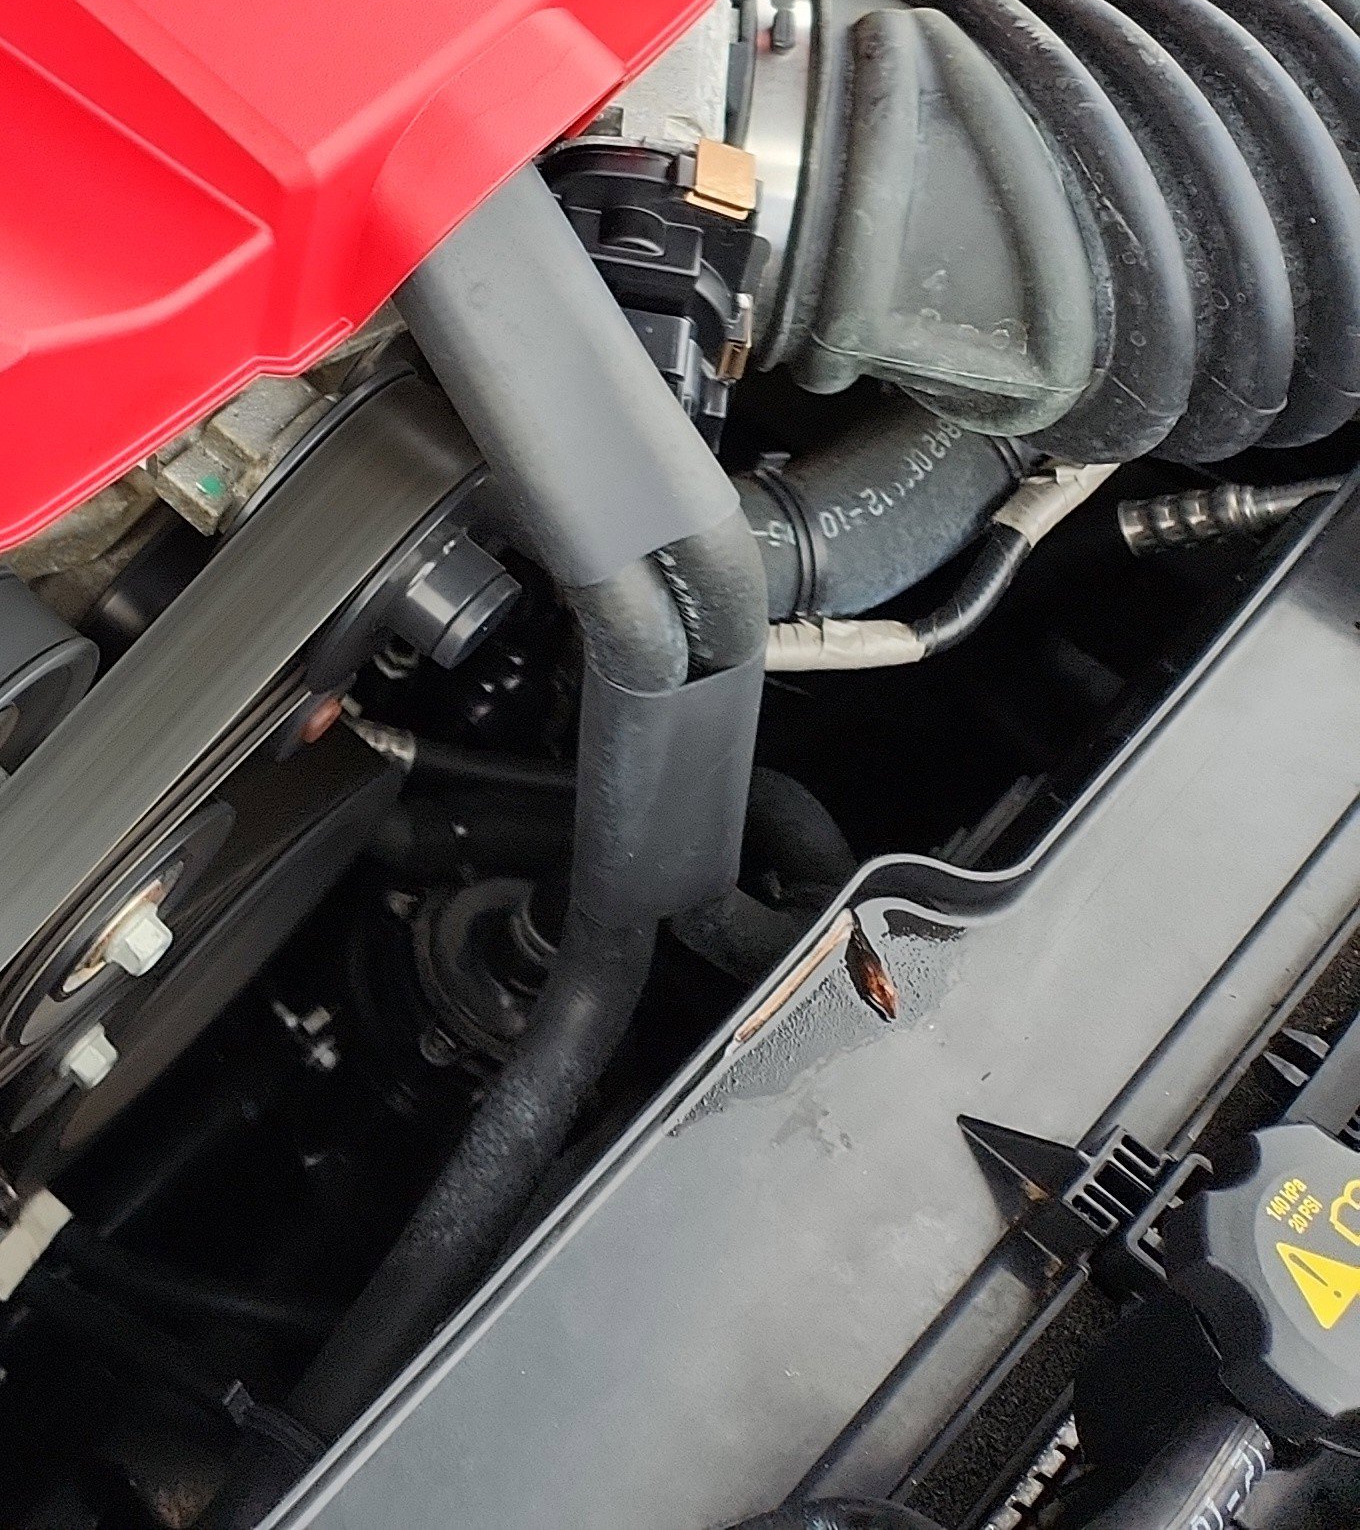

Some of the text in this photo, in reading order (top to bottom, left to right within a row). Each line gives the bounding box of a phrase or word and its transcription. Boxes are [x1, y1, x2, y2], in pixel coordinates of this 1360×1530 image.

[1265, 1178, 1307, 1221] 140 kPa
[1288, 1195, 1323, 1234] 20 PSI
